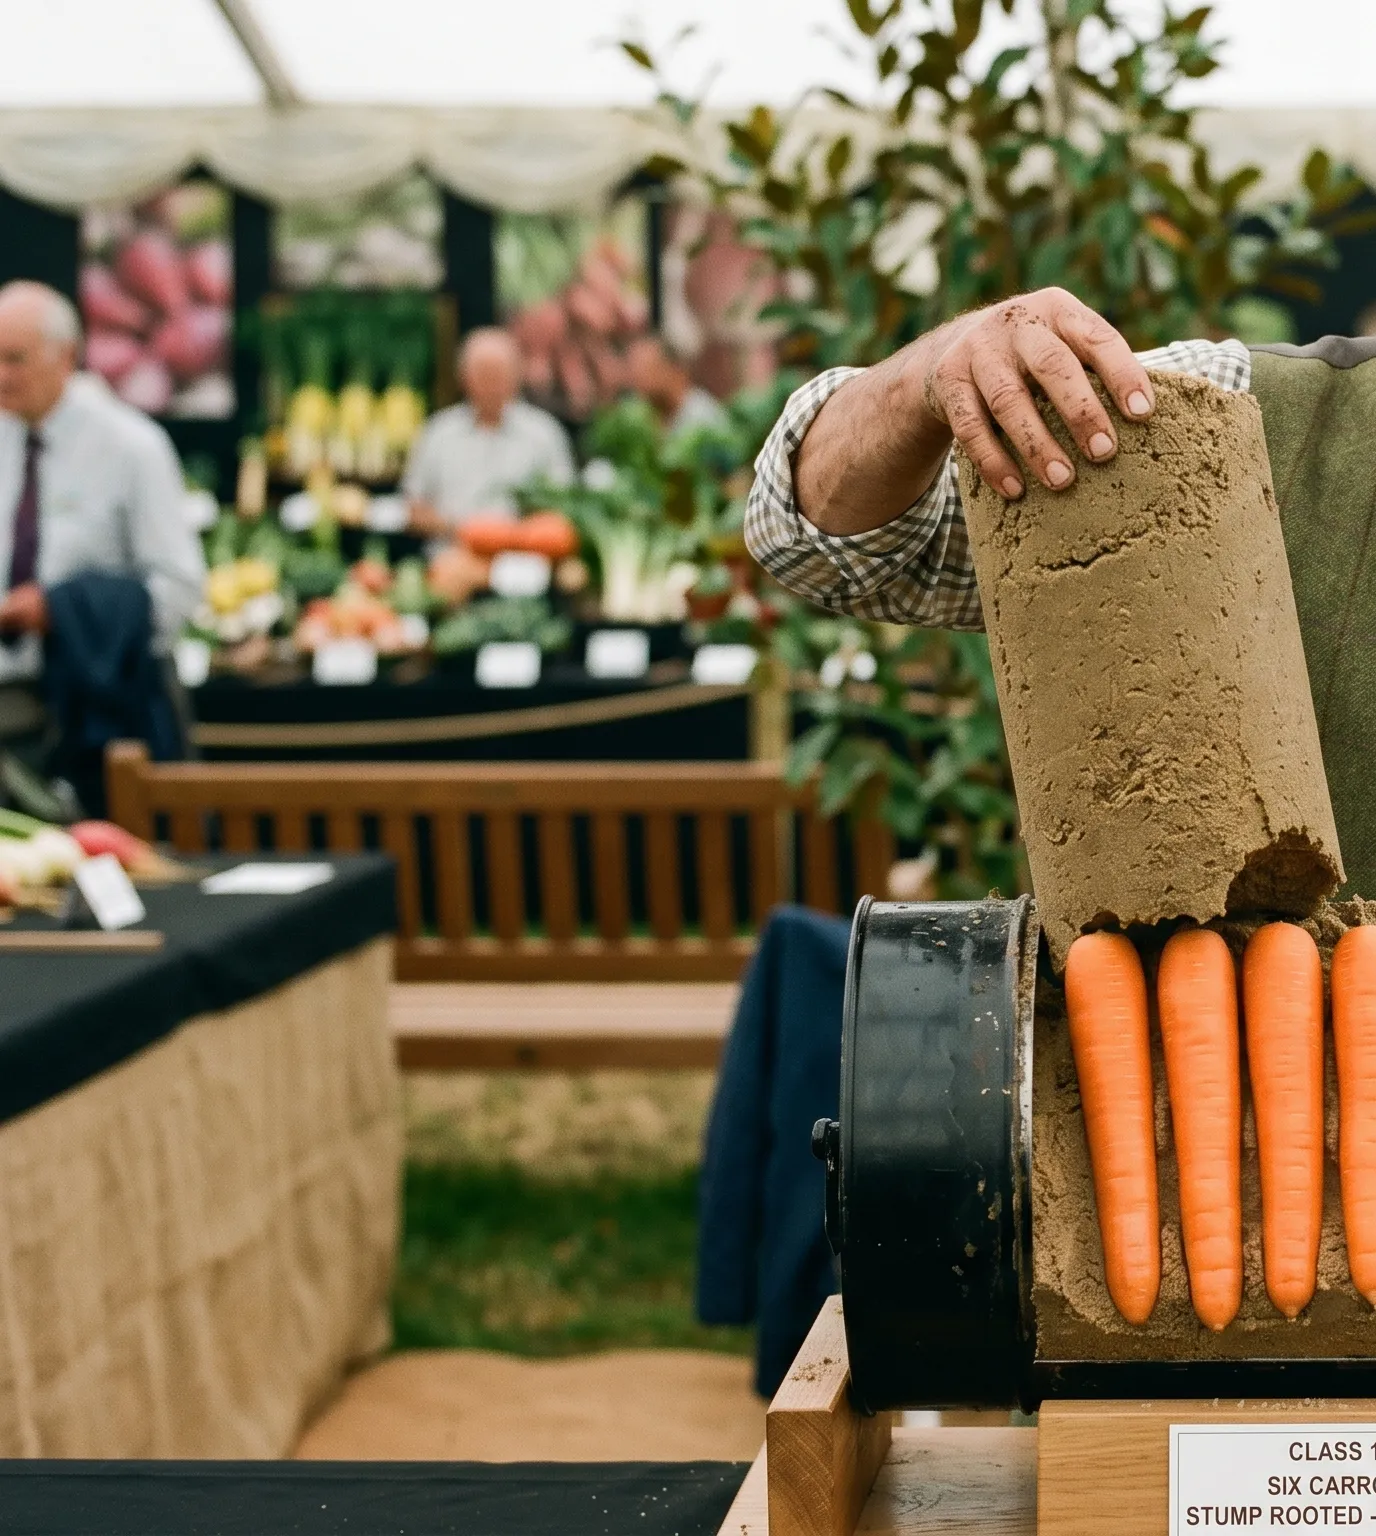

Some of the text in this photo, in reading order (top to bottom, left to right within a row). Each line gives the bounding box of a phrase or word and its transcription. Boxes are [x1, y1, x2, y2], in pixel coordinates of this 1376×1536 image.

[1288, 1441, 1362, 1462] CLASS
[1267, 1475, 1302, 1496] SIX
[1186, 1506, 1262, 1526] STUMP
[1270, 1505, 1363, 1525] ROOTED
